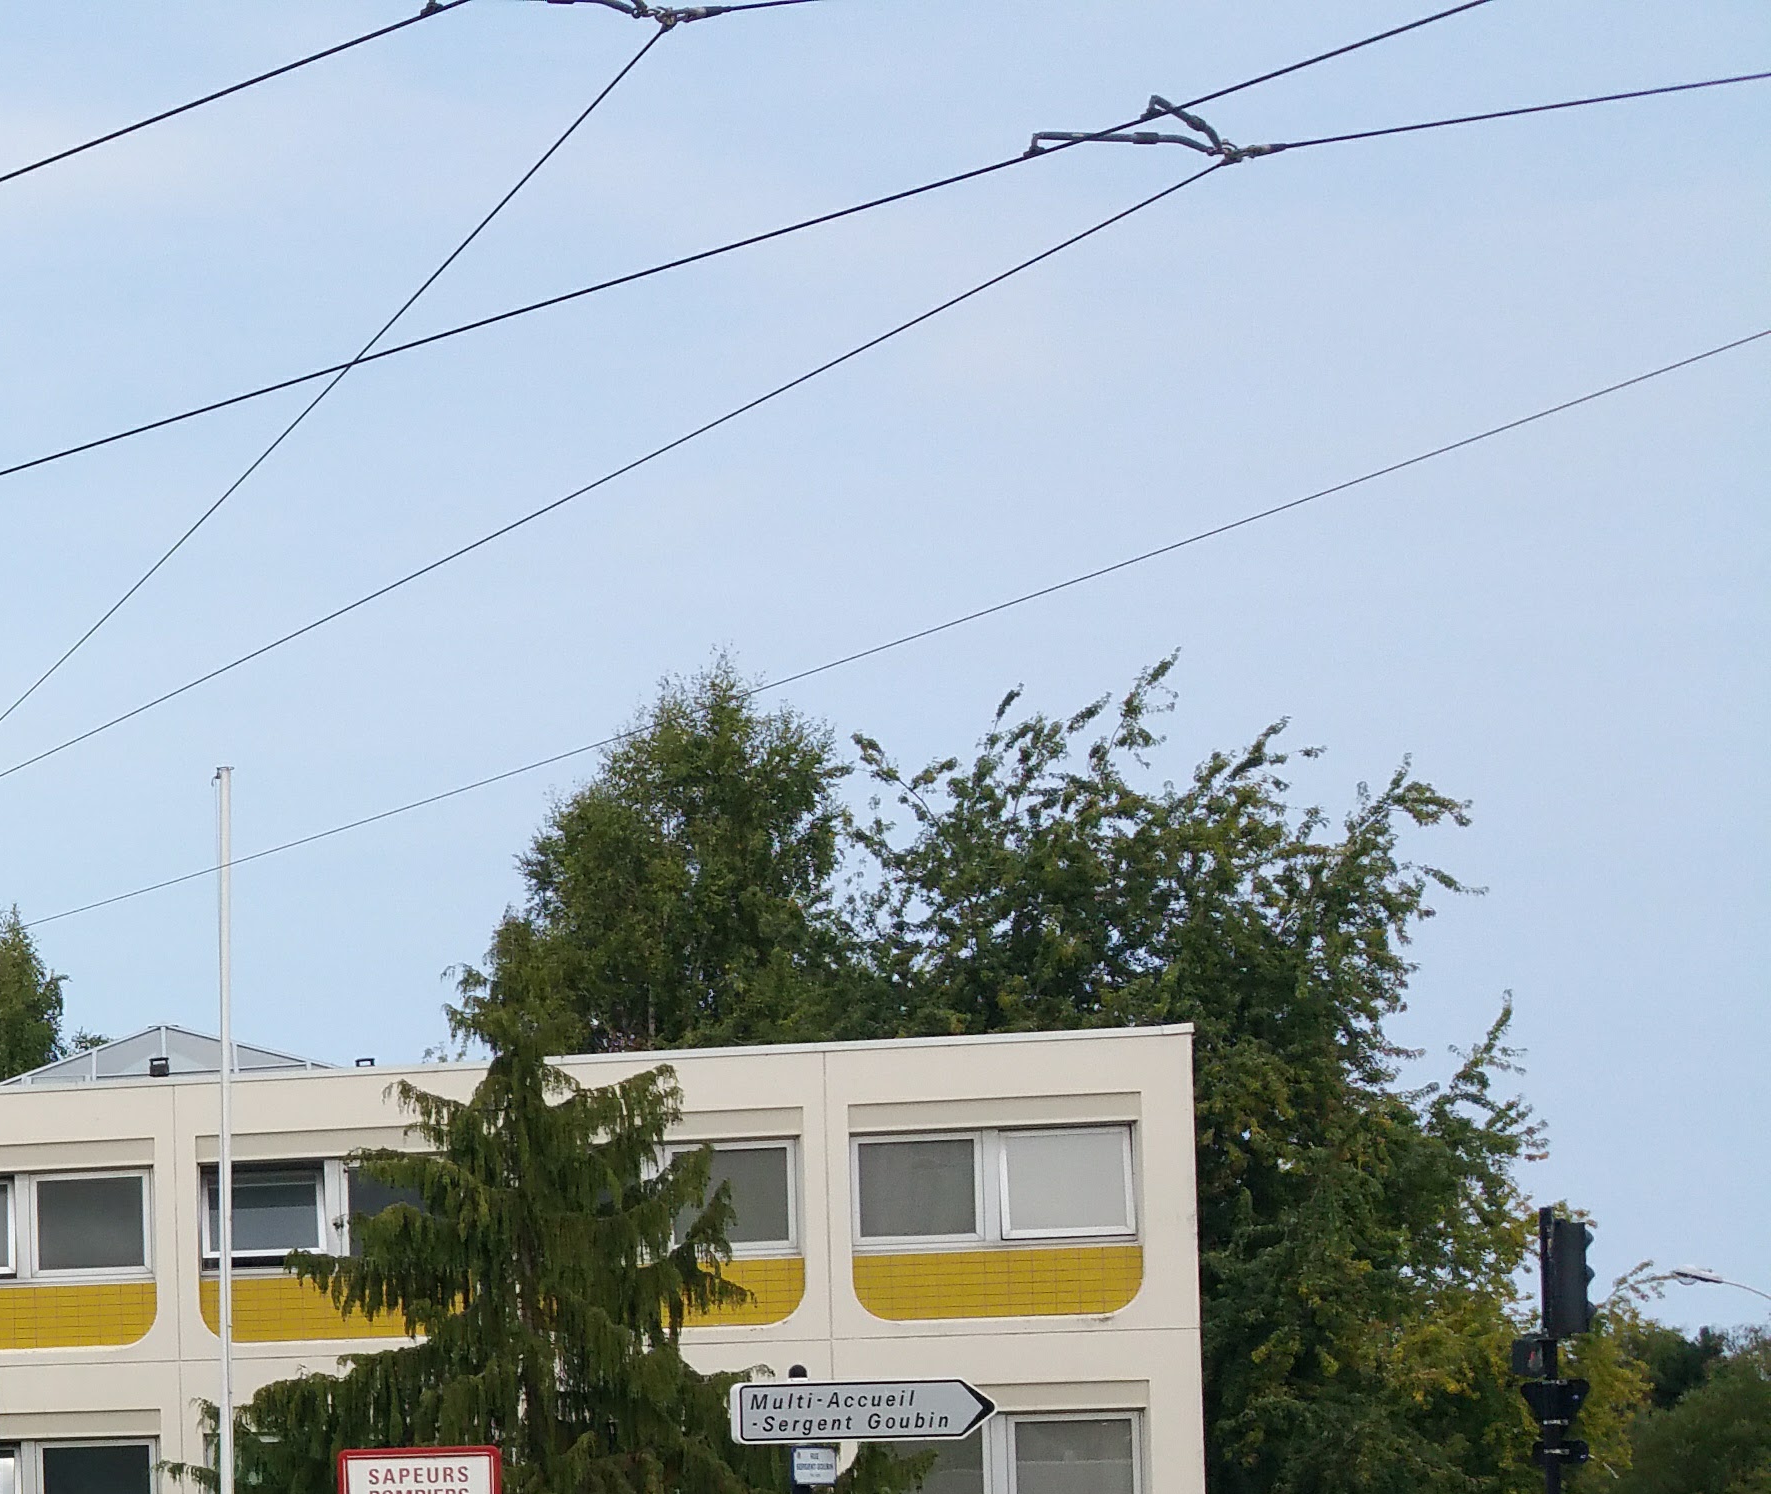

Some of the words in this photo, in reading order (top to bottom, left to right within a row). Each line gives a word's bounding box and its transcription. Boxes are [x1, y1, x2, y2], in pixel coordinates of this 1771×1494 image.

[750, 1389, 915, 1411] Multi-Accueil
[867, 1411, 949, 1430] Goubin
[368, 1466, 469, 1485] SAPEURS
